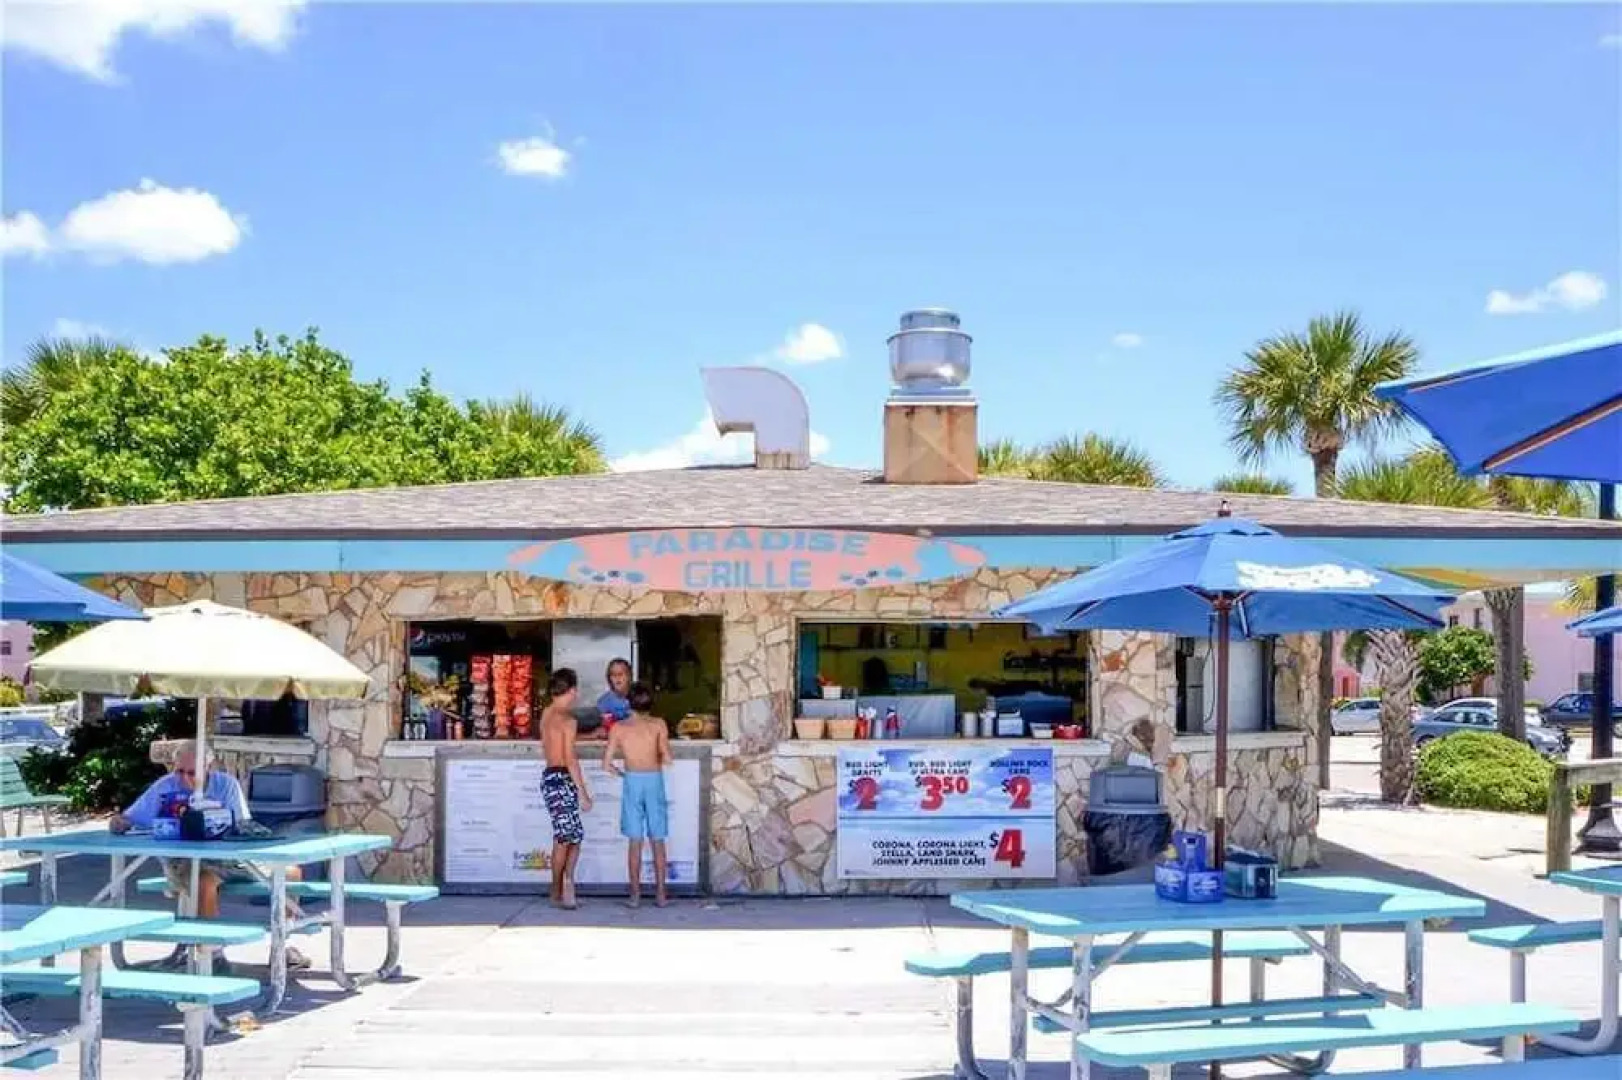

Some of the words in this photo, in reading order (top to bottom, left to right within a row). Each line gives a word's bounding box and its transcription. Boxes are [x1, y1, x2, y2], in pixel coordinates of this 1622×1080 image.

[630, 528, 870, 559] PARADISE
[684, 560, 812, 589] GRILLE
[848, 777, 878, 810] $2
[1001, 776, 1032, 809] $2
[872, 840, 914, 850] CORONA,
[917, 839, 956, 849] CORONA
[959, 840, 986, 850] LIGHT,
[918, 849, 943, 857] LAND
[989, 829, 1026, 868] $4
[872, 858, 909, 867] JOHNNY
[962, 857, 986, 867] CANS
